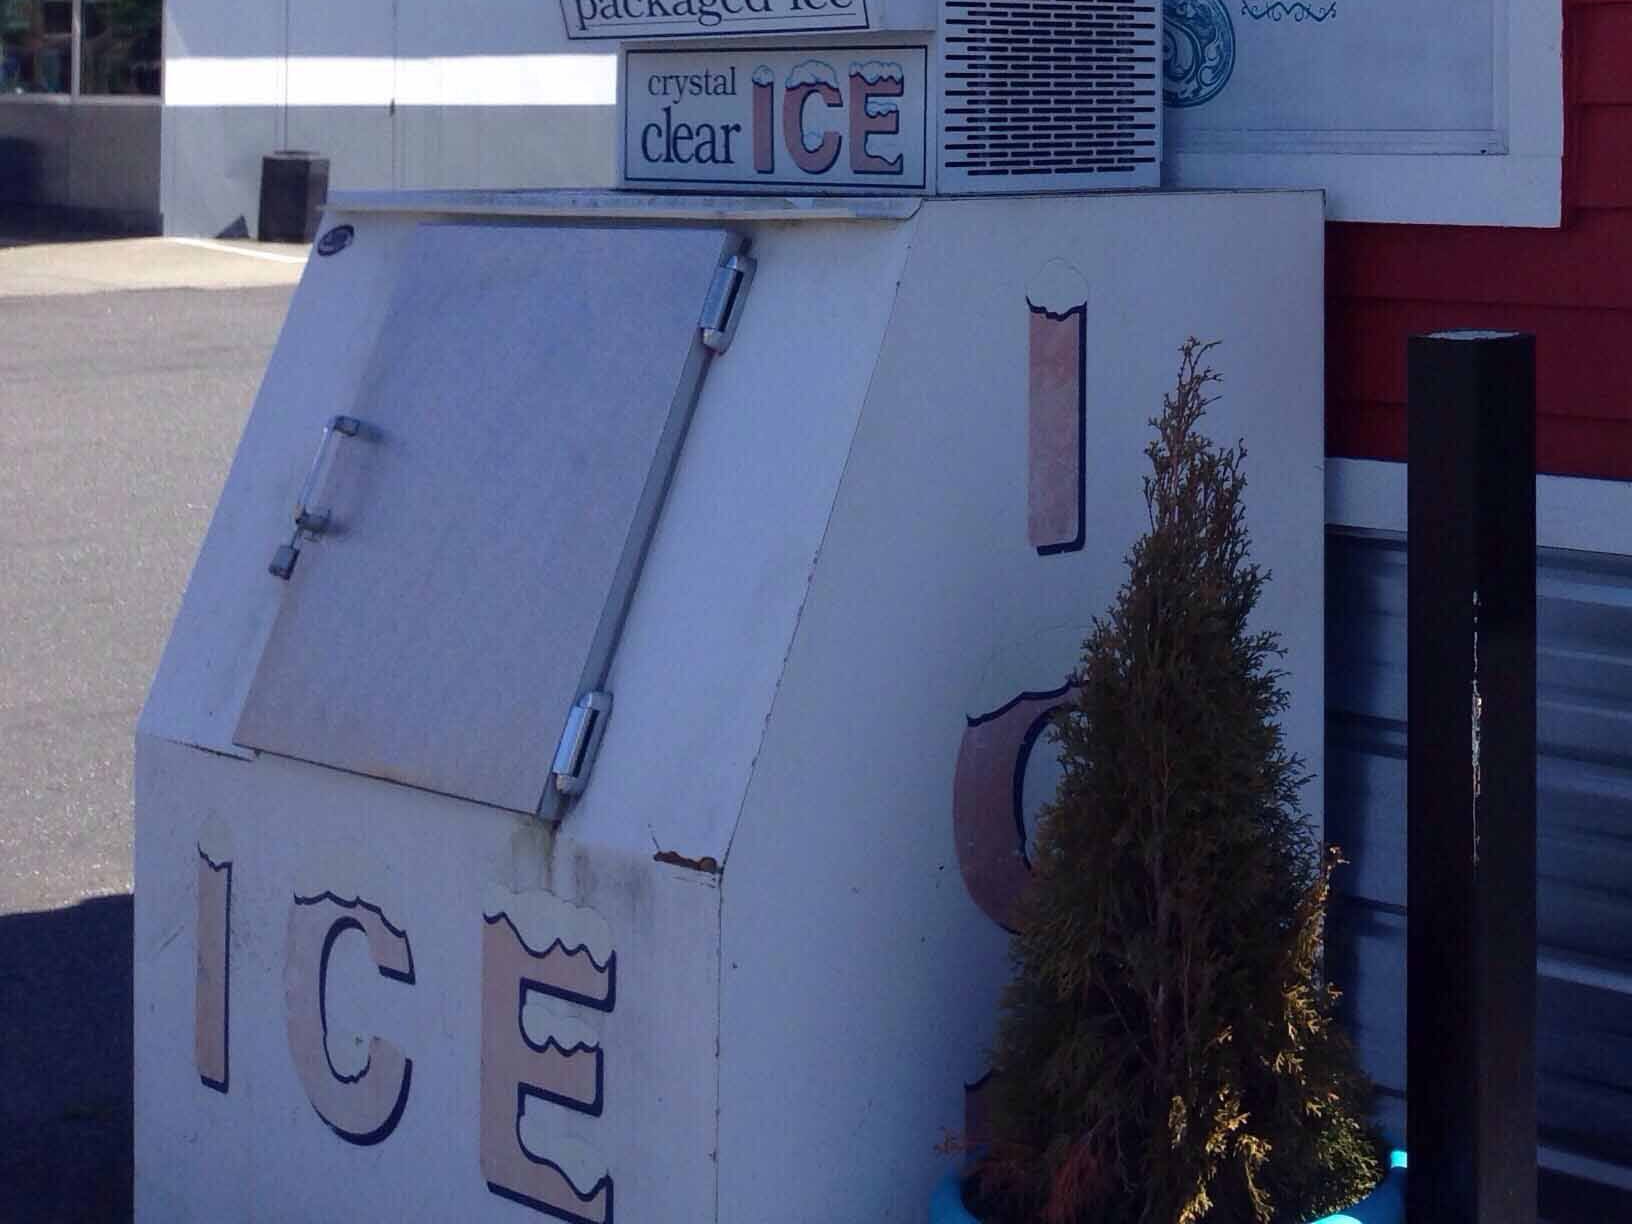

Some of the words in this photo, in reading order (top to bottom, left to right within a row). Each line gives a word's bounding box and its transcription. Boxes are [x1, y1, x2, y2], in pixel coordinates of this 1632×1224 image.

[647, 66, 737, 104] crystal
[752, 59, 905, 174] ICE
[640, 108, 741, 165] clear
[193, 840, 617, 1224] ICE
